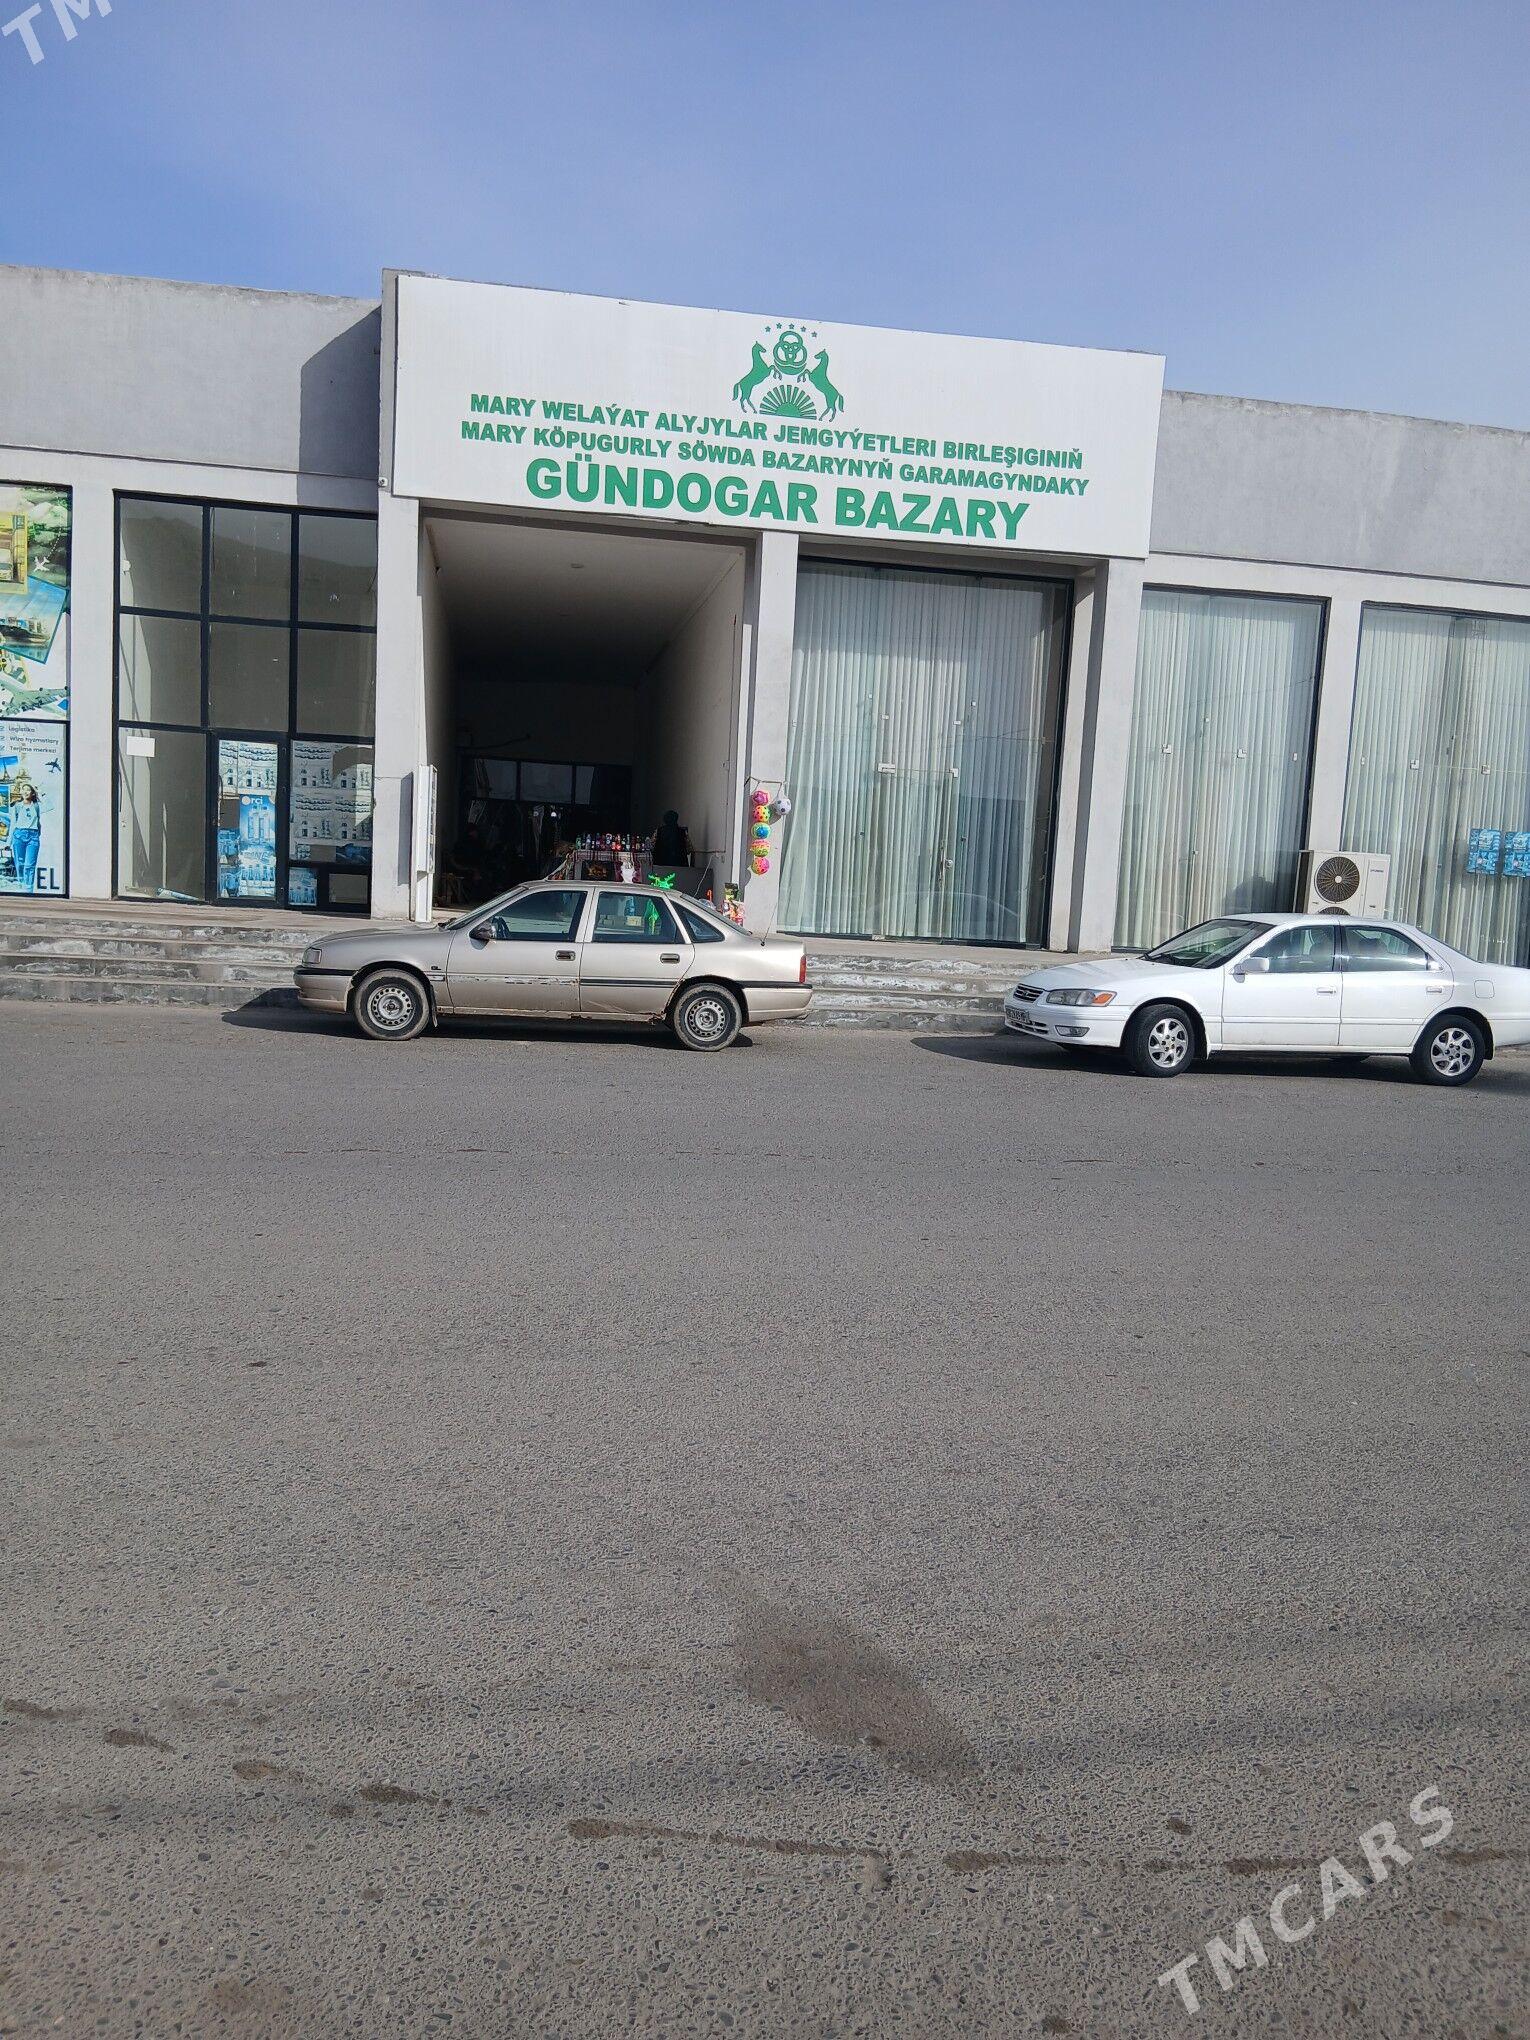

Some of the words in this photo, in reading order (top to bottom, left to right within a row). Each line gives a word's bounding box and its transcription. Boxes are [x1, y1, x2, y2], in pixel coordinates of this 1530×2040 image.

[460, 420, 527, 445] MARY
[532, 426, 673, 459] KÖPUGURLY
[677, 439, 756, 468] SÖWDA
[762, 449, 894, 481] BAZARYNYŇ
[898, 463, 1090, 497] GARAMAGYNDAKY
[470, 392, 537, 418] MARY
[541, 400, 650, 429] WELAÝAT
[654, 412, 769, 442] ALYJYLAR
[773, 424, 937, 458] JEMGYÝETLERI
[942, 440, 1083, 471] BIRLEŞIGINIŇ
[525, 452, 819, 525] GÜNDOGAR
[835, 486, 1031, 542] BAZARY
[36, 867, 60, 890] EL
